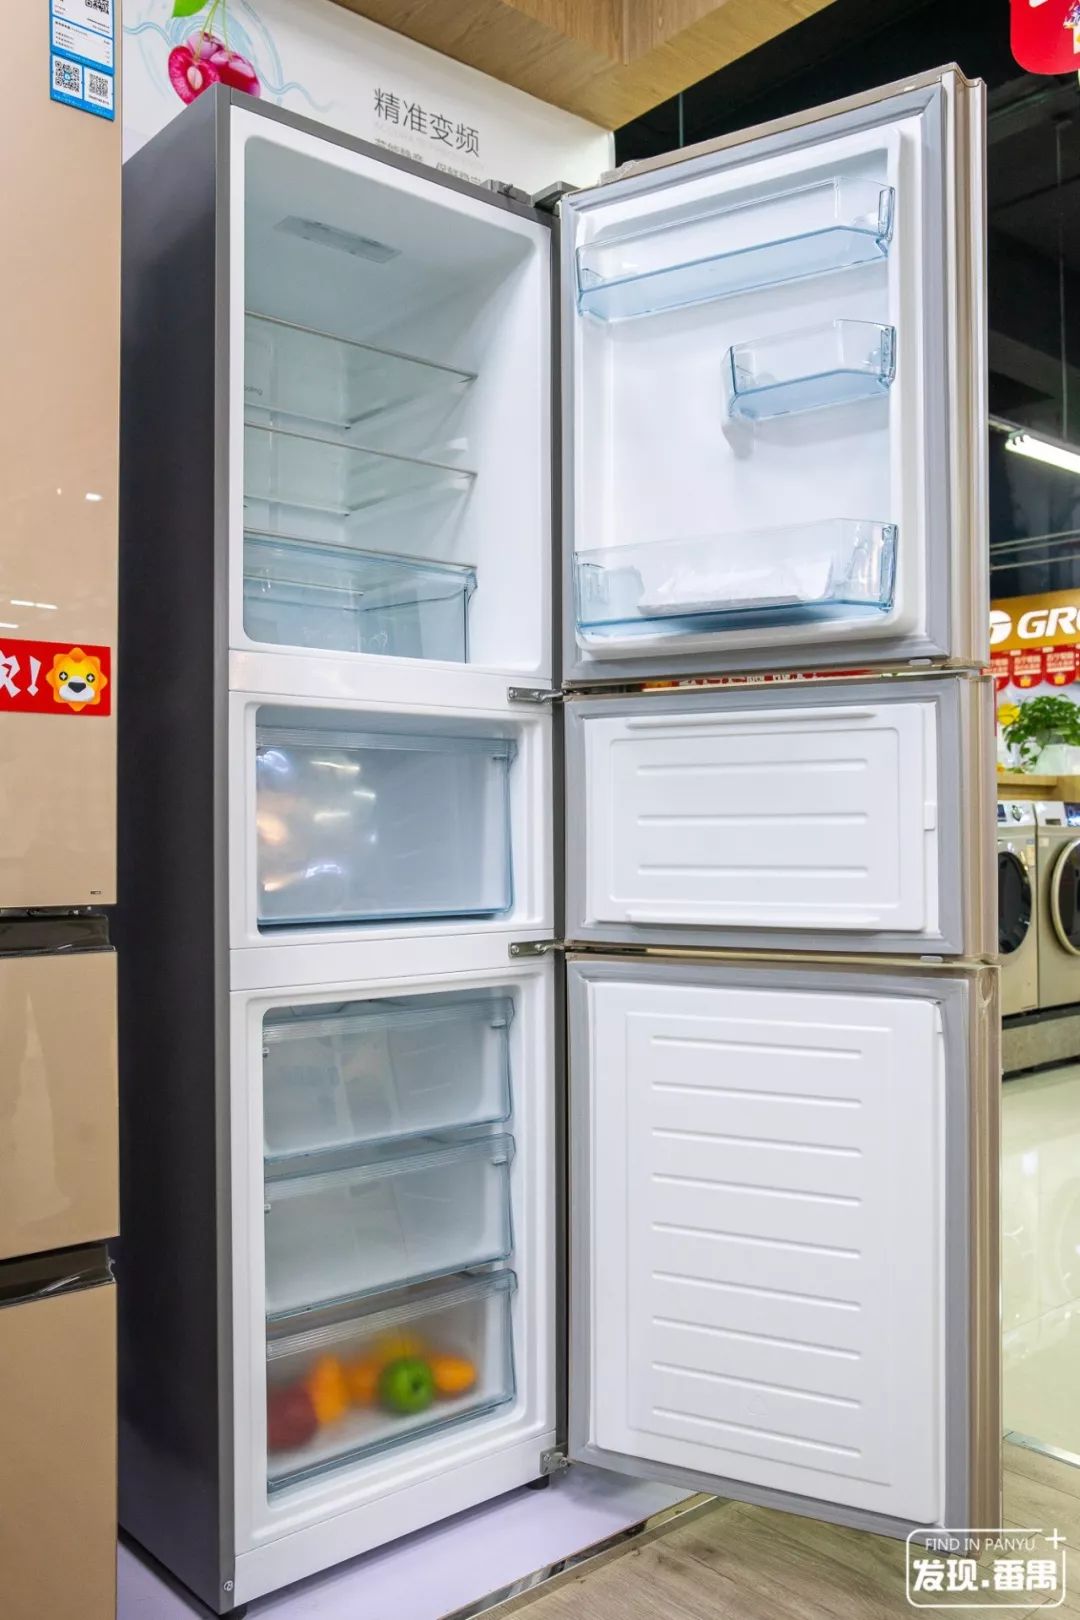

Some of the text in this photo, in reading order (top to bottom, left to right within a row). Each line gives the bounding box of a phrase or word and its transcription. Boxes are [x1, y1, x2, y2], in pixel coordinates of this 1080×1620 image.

[374, 87, 480, 158] 精准变频
[1017, 606, 1080, 639] GR
